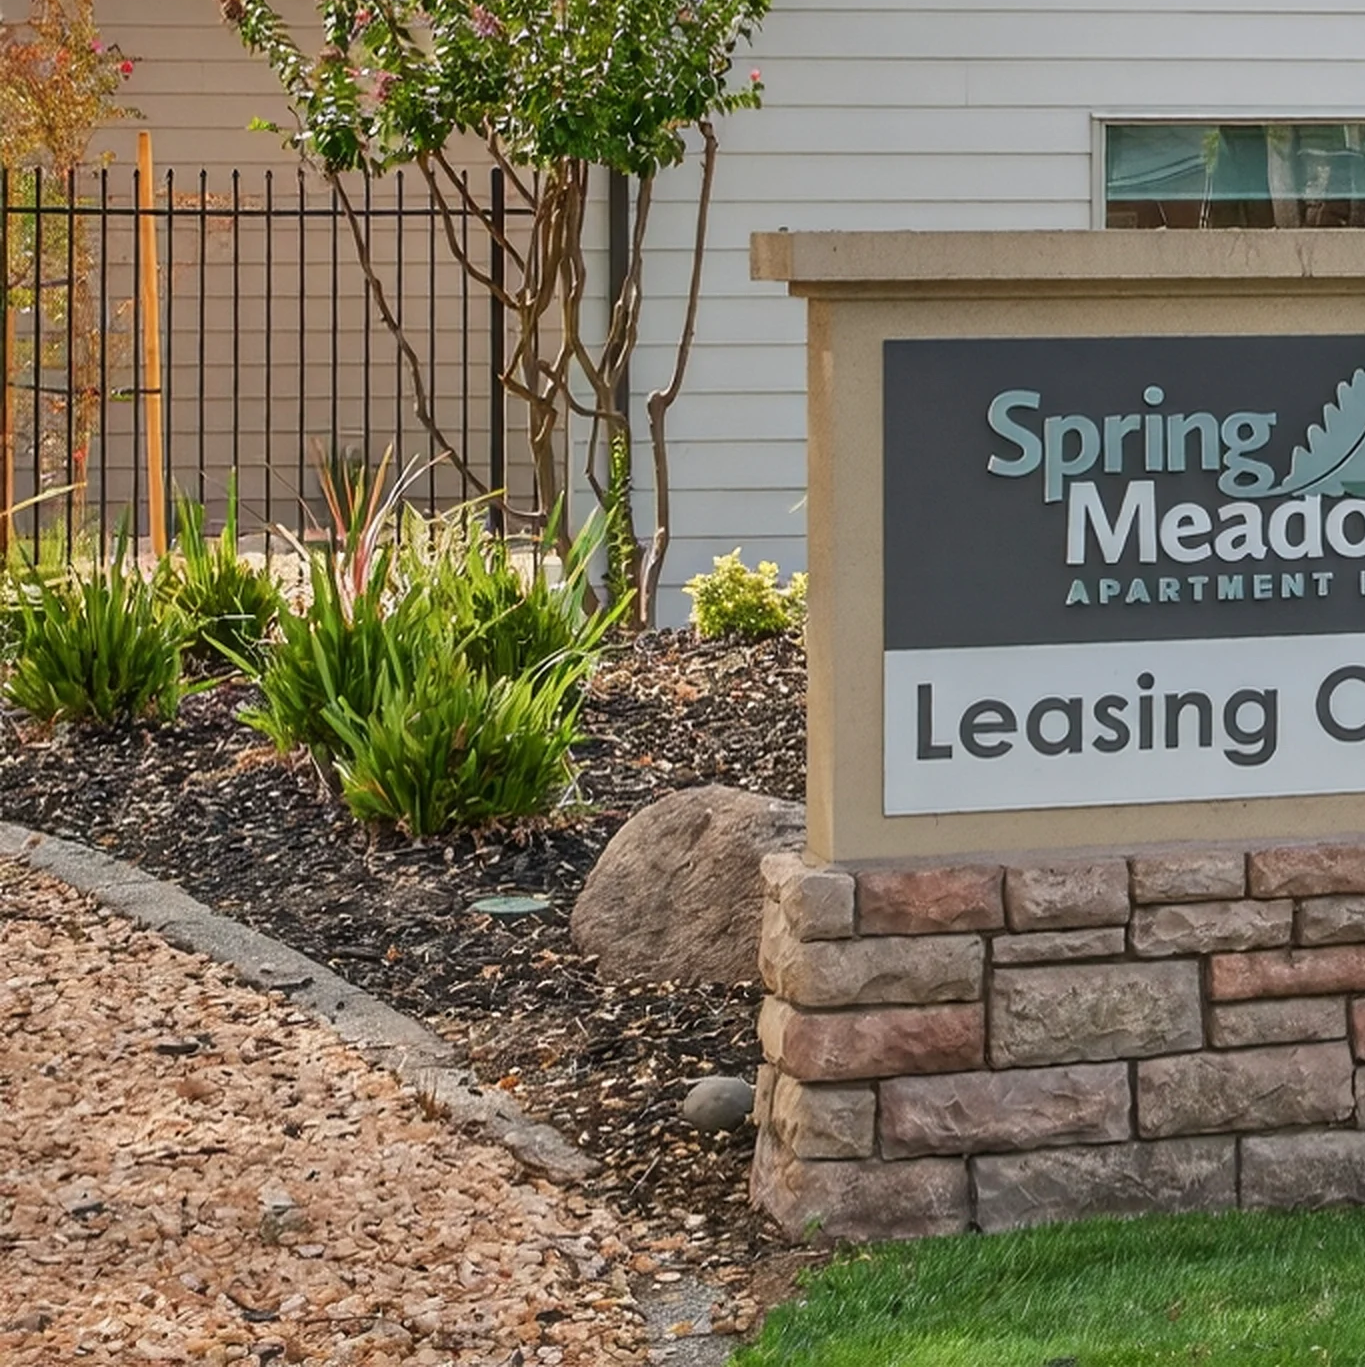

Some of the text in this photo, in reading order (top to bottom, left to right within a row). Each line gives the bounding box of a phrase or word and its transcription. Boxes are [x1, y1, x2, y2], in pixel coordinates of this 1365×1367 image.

[988, 386, 1277, 502] Spring
[1065, 571, 1334, 606] APARTMENT
[916, 671, 1279, 767] Leasing
